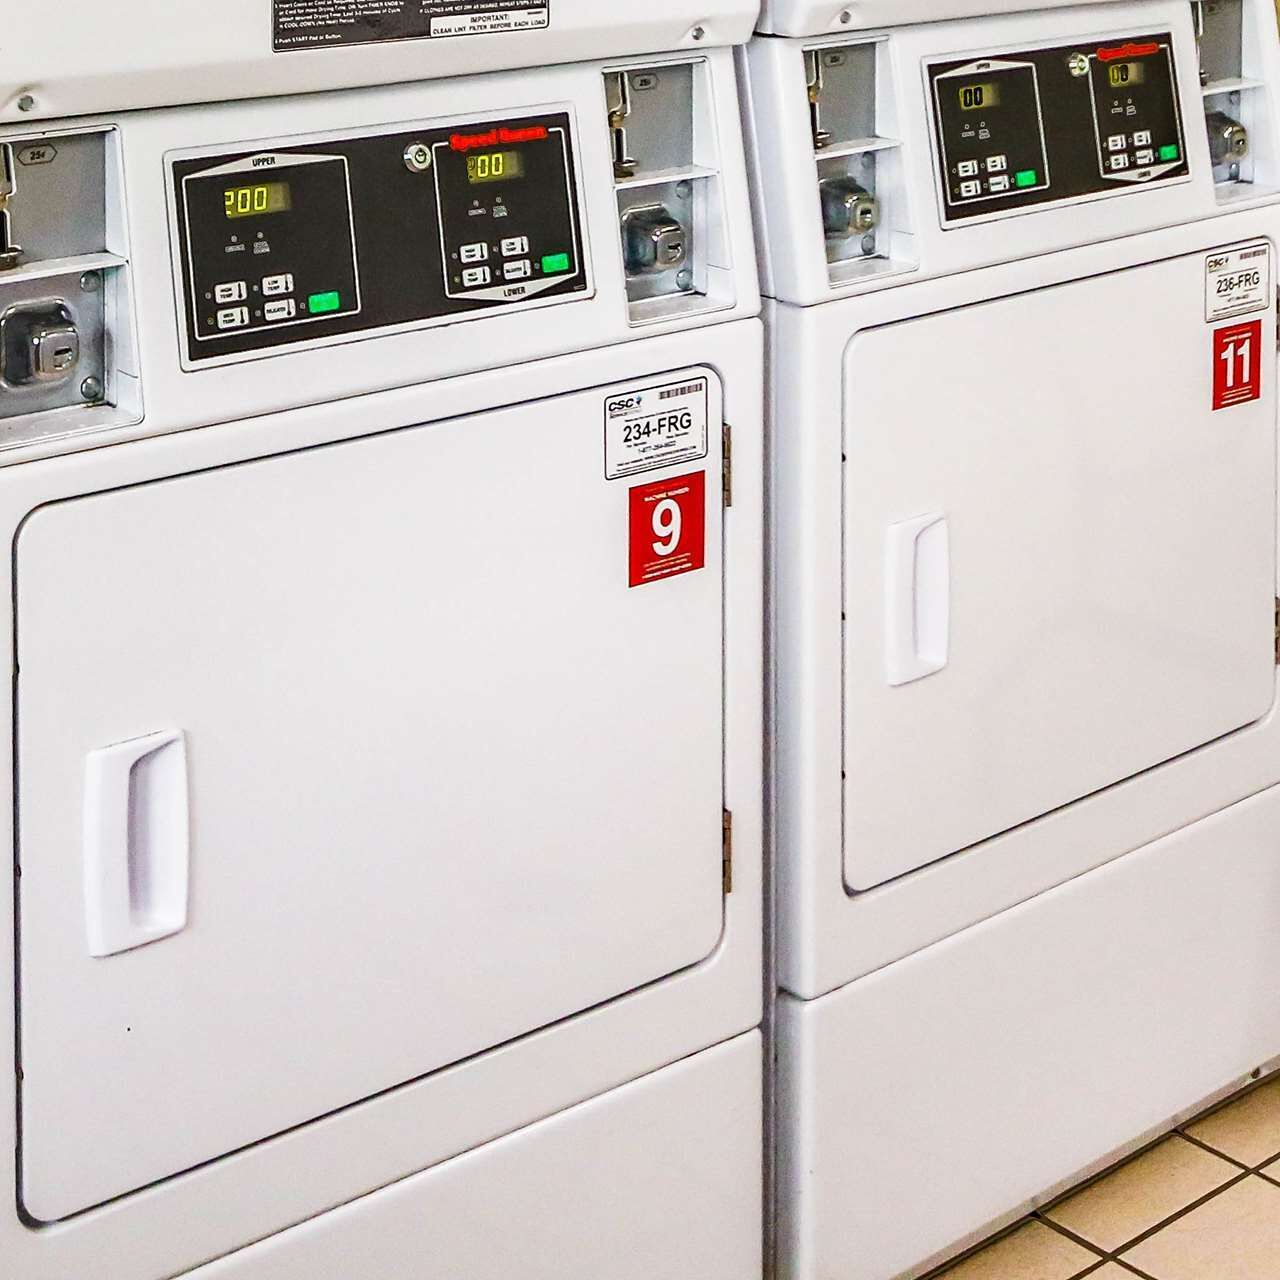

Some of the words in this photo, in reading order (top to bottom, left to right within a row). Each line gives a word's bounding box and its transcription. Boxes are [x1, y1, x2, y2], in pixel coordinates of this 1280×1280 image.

[29, 150, 46, 160] 25¢
[252, 156, 276, 167] UPPER
[503, 286, 526, 297] LOWER
[1216, 271, 1260, 294] 236-FRG
[1220, 338, 1250, 388] 11
[608, 397, 634, 412] CSC
[623, 412, 692, 443] 234-FRG
[651, 499, 682, 556] 9
